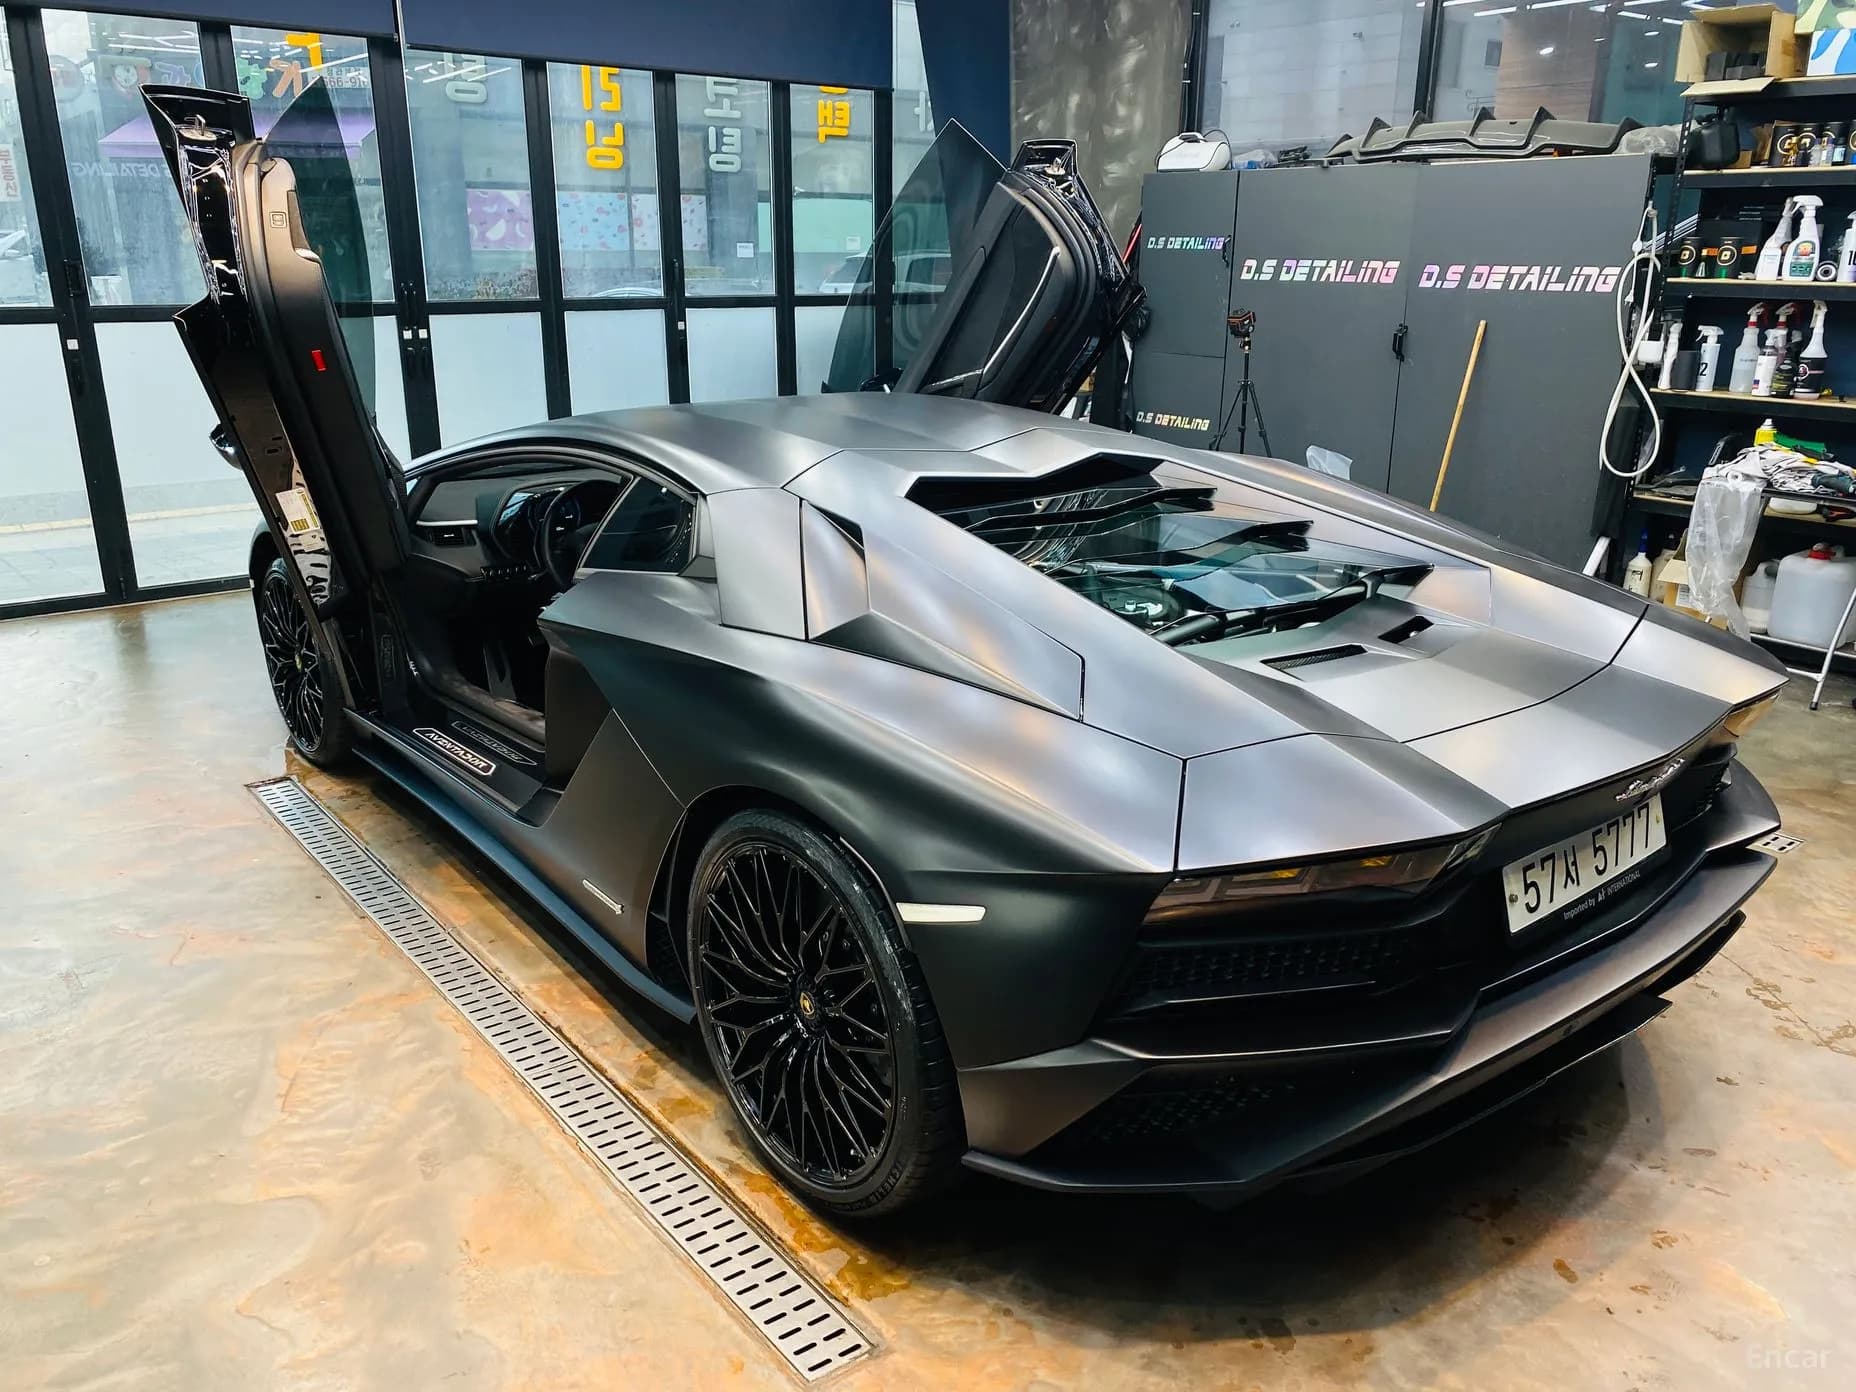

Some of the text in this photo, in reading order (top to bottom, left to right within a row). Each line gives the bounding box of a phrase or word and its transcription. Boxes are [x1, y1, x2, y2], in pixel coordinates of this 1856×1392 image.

[1147, 236, 1224, 250] D.S DETAILING
[1240, 258, 1401, 284] D.S DETAILING
[1418, 264, 1622, 293] D.S DETAILING
[1136, 411, 1211, 431] D.S DETAILING
[1522, 802, 1650, 914] 57서 5777
[1563, 900, 1589, 921] Imported
